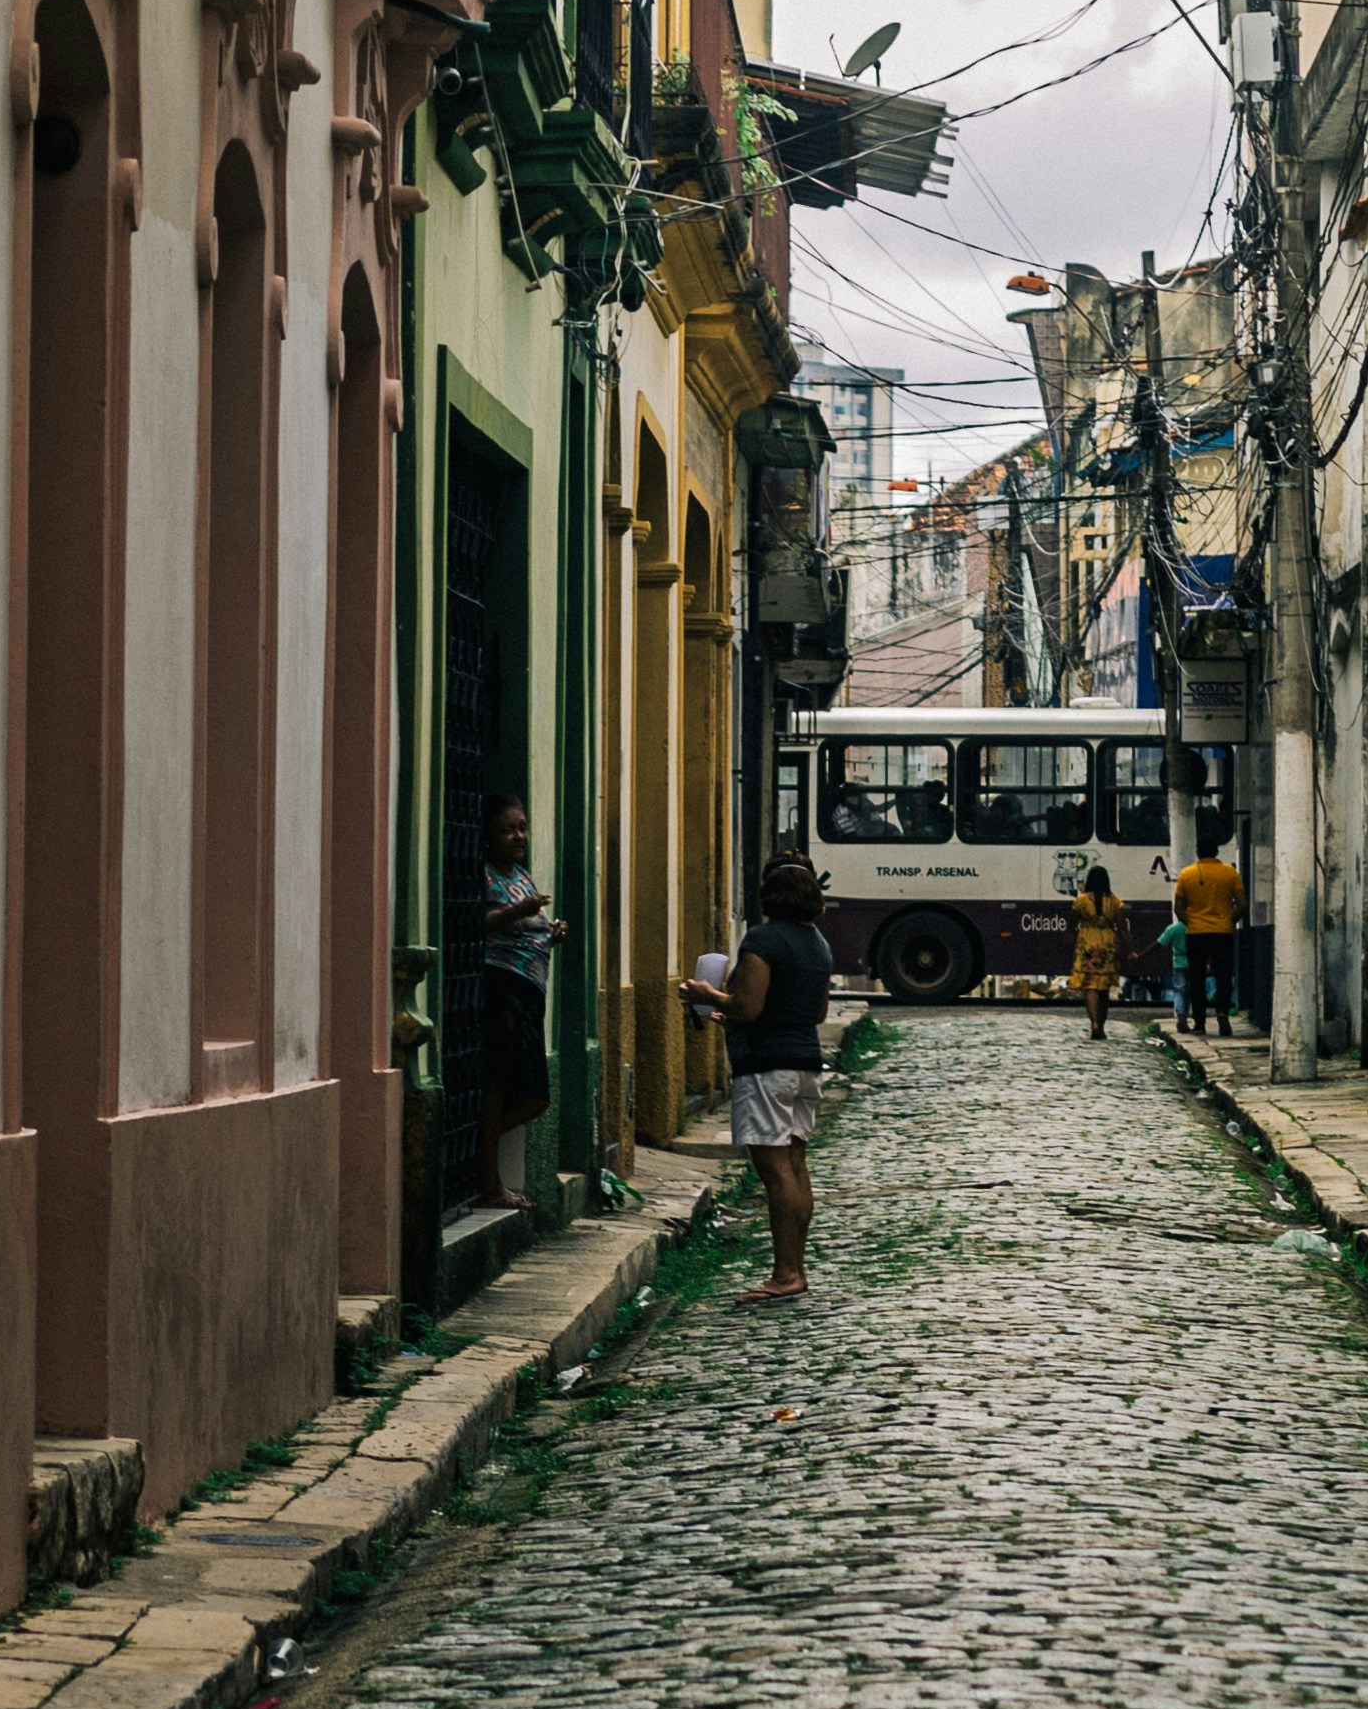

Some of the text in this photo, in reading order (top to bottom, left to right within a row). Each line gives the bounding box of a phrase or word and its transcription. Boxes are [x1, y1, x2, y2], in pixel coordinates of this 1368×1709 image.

[876, 866, 979, 878] TRANSP. ARSENAL
[1021, 913, 1067, 932] Cidade
